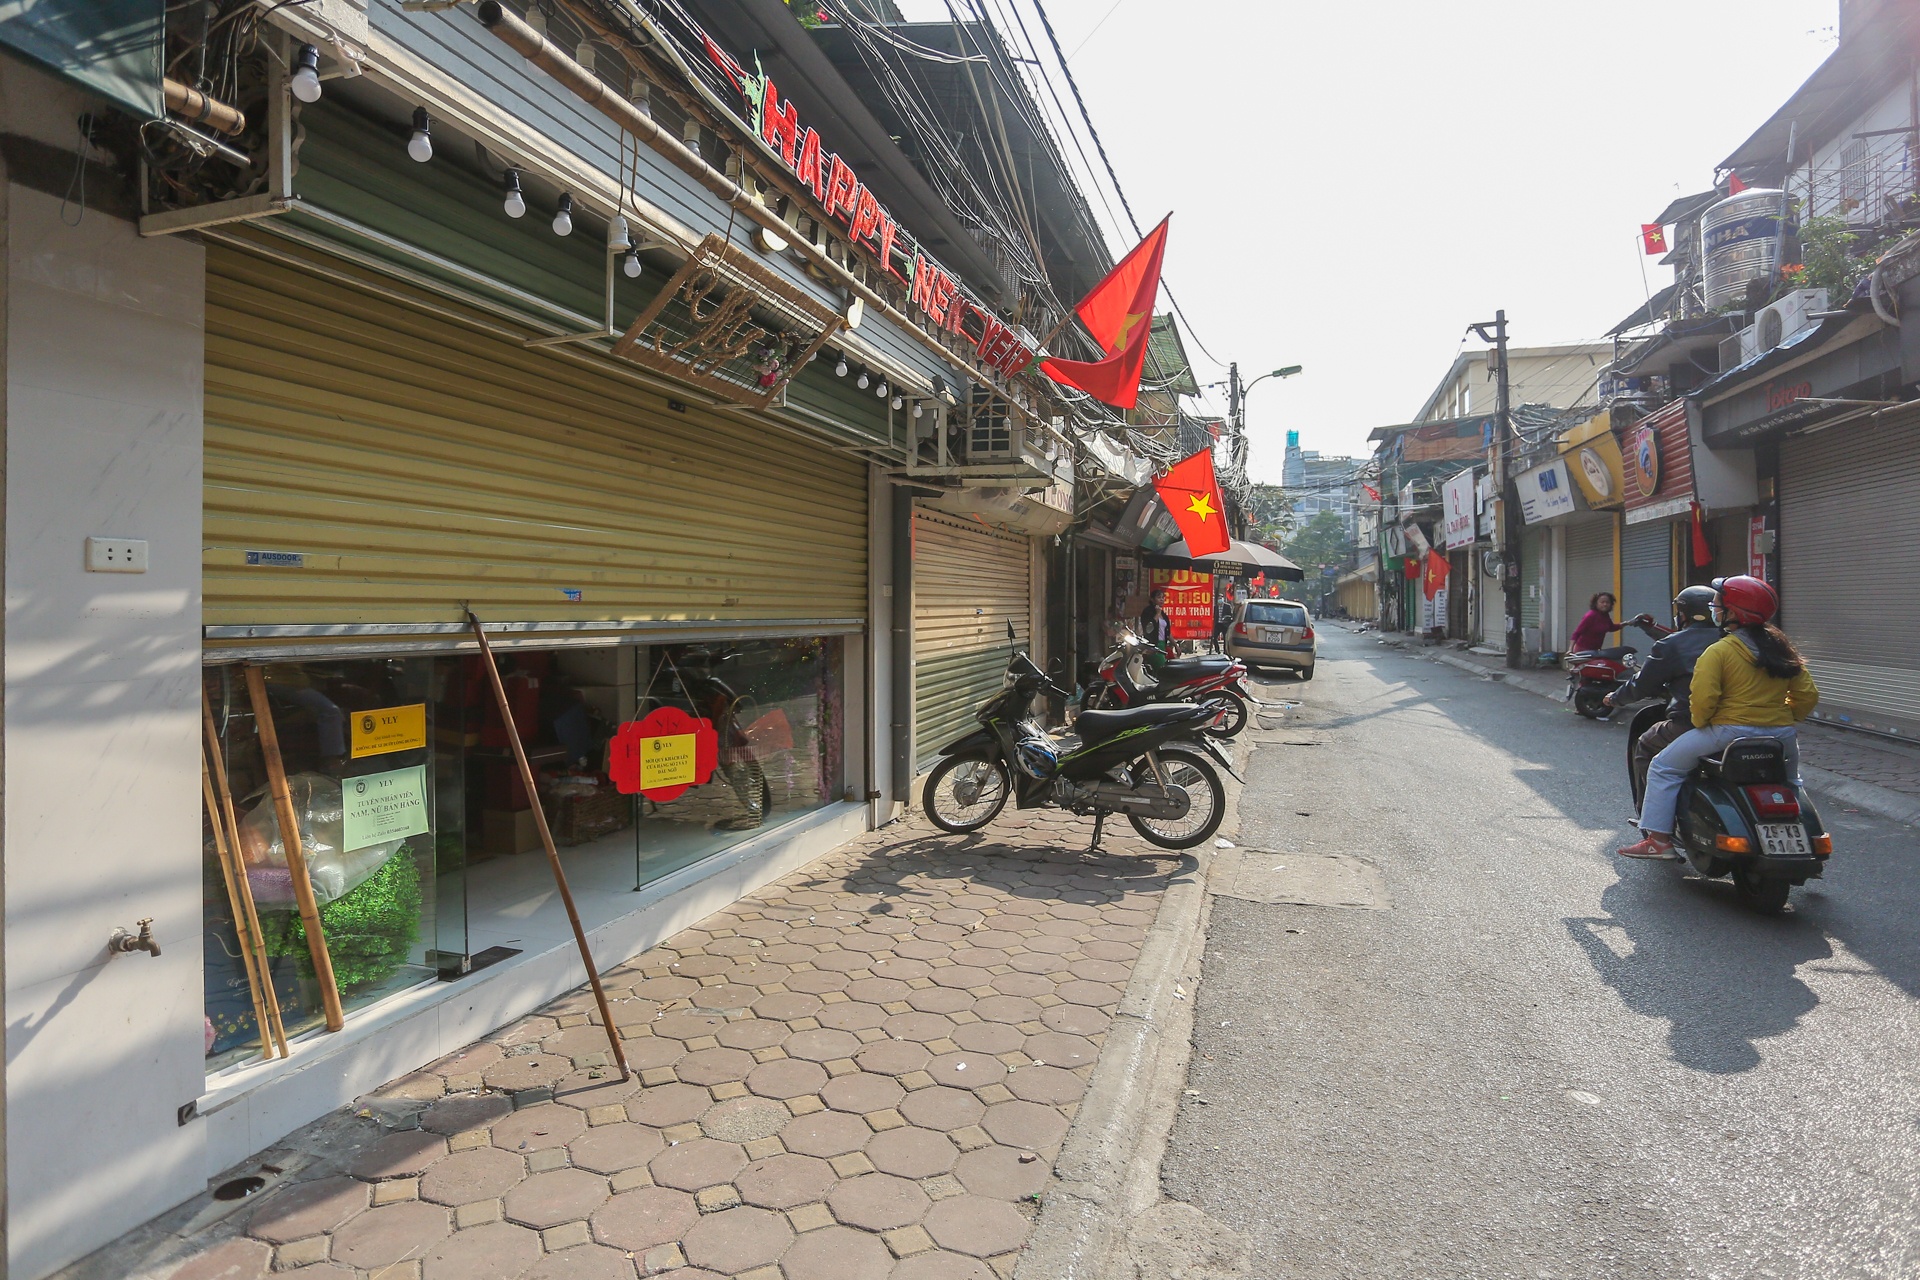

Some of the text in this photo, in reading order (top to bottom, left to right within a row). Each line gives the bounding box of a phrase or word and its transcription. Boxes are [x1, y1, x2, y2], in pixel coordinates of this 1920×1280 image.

[761, 75, 896, 271] HAPPY
[912, 253, 971, 338] NEW
[1763, 382, 1811, 412] Totoro
[262, 553, 297, 561] AUSDOOR
[1178, 590, 1211, 604] RIÊU
[381, 715, 398, 725] YLY
[379, 779, 395, 788] YLY
